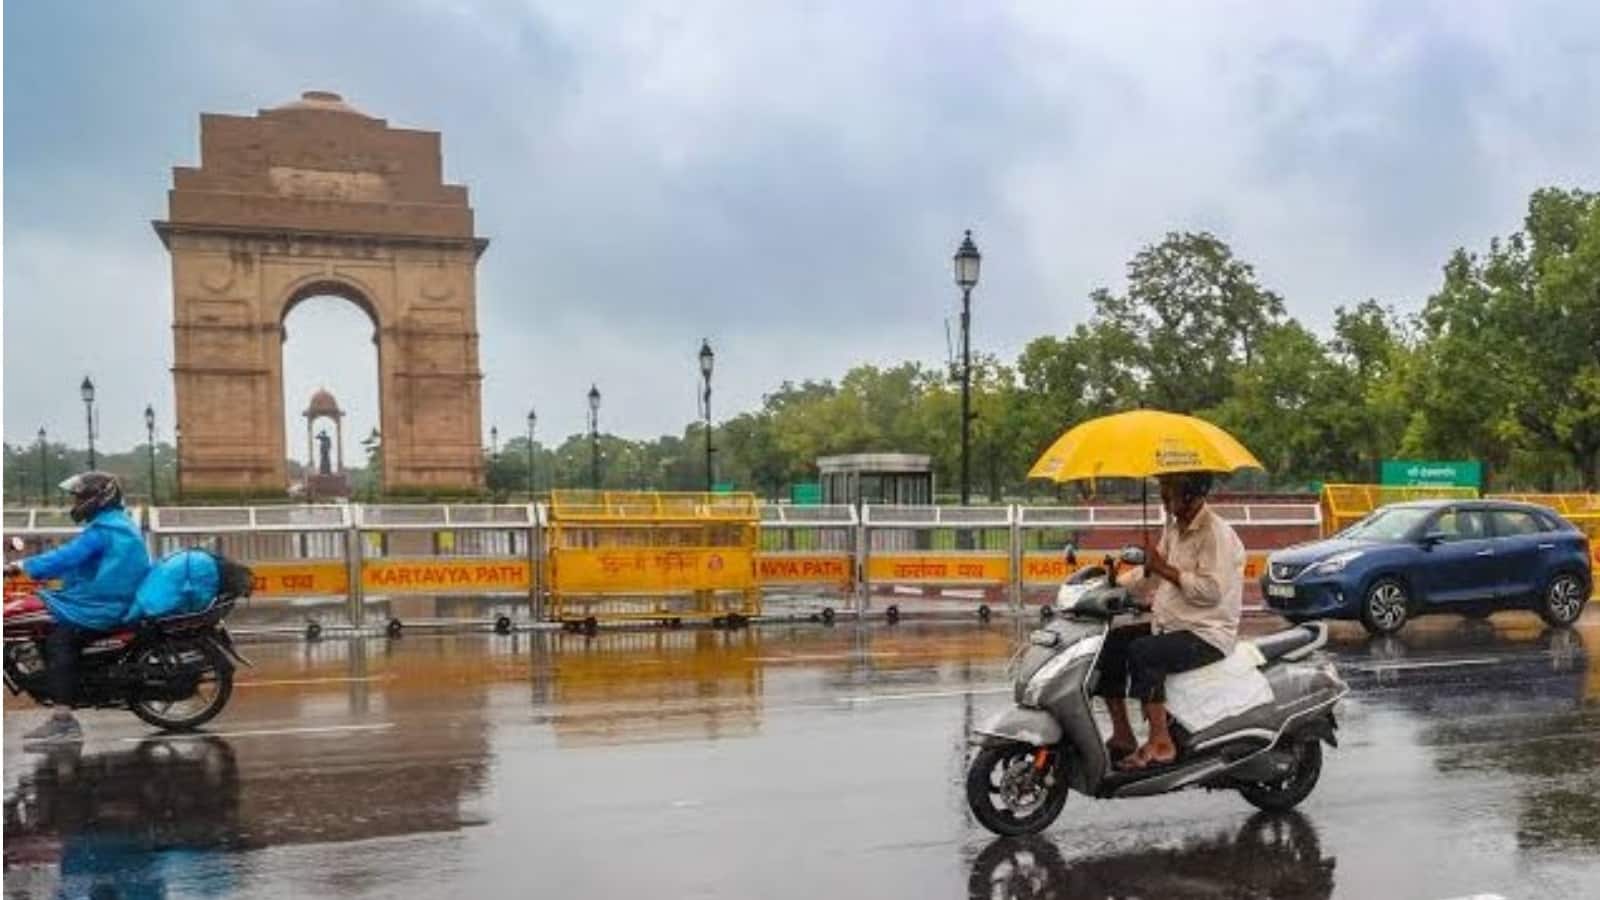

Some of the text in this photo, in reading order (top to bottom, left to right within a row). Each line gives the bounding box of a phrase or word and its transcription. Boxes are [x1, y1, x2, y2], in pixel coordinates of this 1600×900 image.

[370, 566, 523, 585] KARTAVYA PATH
[802, 560, 842, 577] PATH
[1029, 561, 1067, 577] KAR
